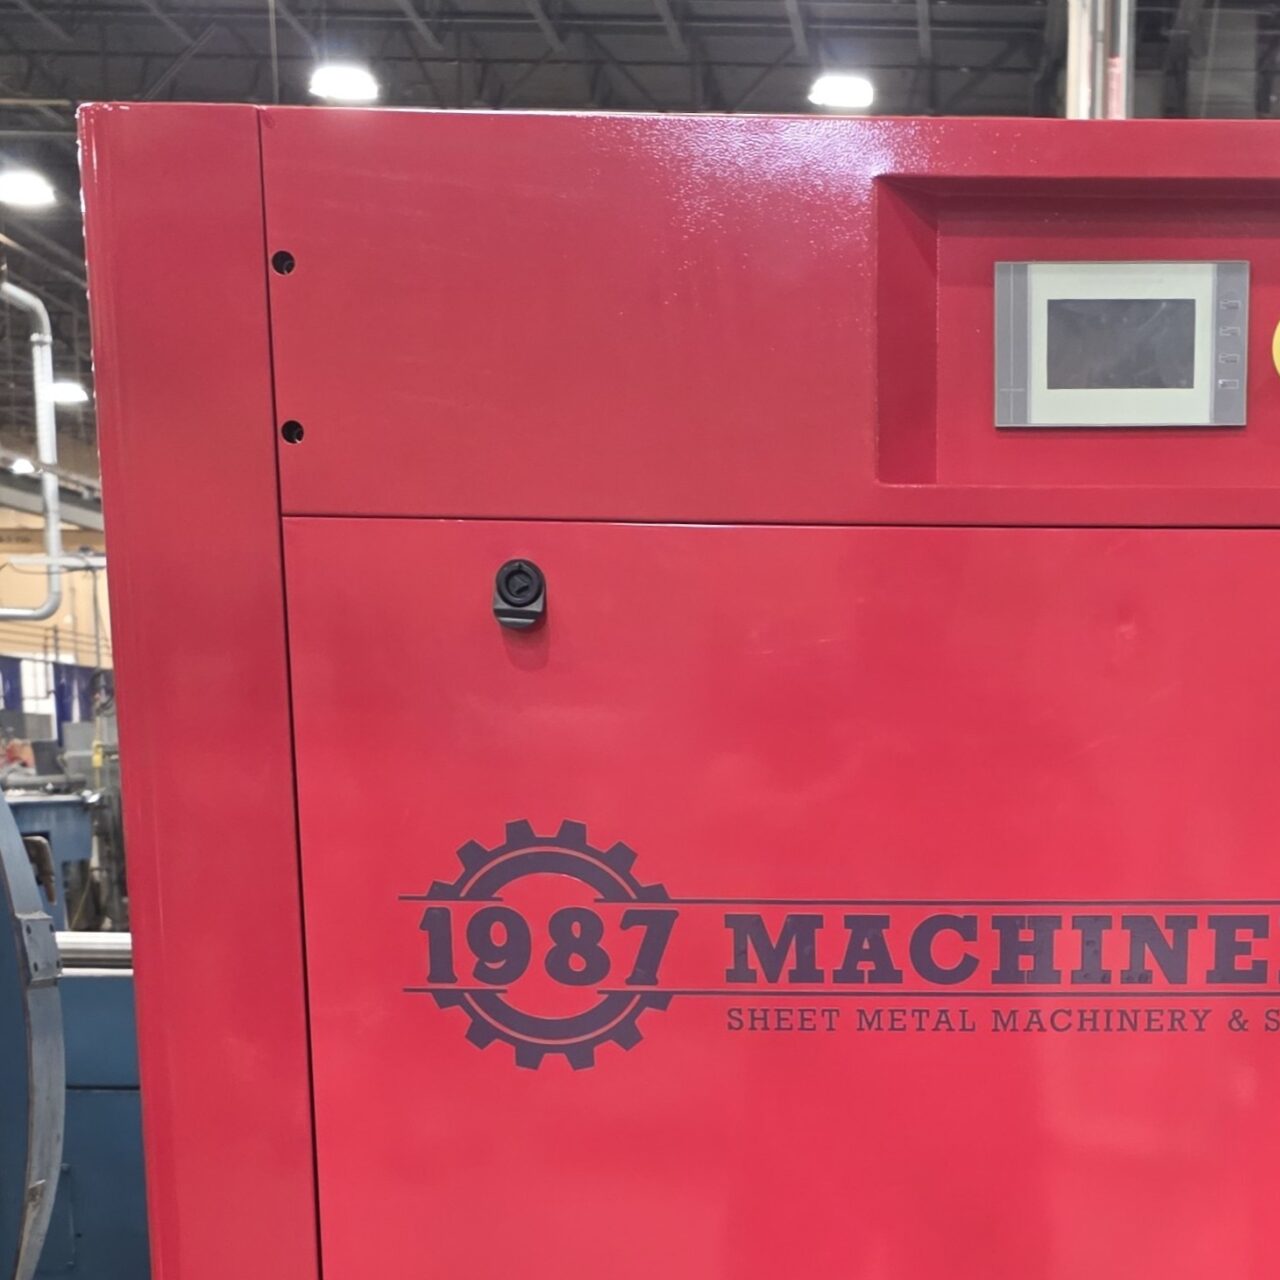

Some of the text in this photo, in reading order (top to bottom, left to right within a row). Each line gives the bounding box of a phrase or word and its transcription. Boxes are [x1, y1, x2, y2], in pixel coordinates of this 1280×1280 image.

[418, 906, 679, 986] 1987
[727, 1008, 840, 1031] SHEET
[856, 1008, 976, 1032] METAL
[991, 1008, 1211, 1032] MACHINERY
[1227, 1009, 1248, 1032] &
